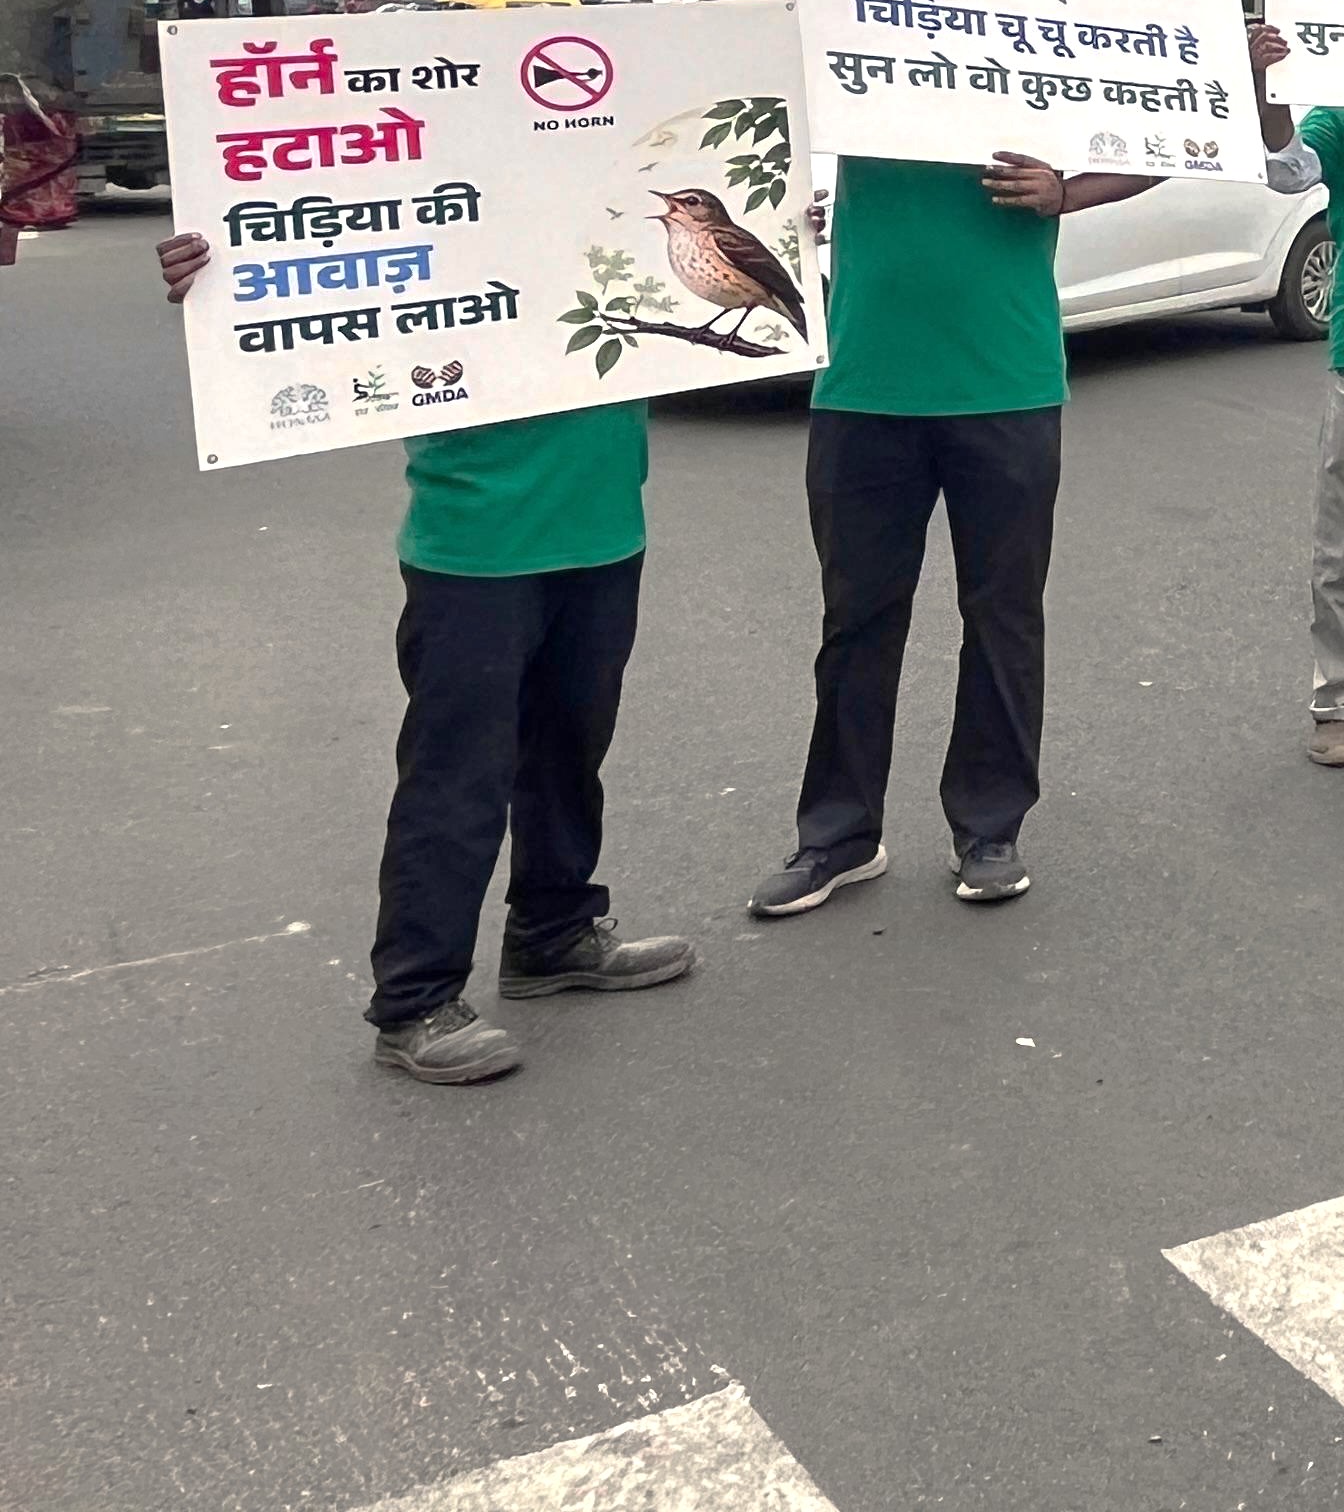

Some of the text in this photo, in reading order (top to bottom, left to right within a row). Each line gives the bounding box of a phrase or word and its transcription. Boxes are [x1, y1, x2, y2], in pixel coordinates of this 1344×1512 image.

[209, 38, 480, 107] हॉर्न का शोर
[996, 13, 1033, 54] चू
[1037, 18, 1076, 58] चू
[1078, 23, 1169, 58] करती
[1173, 27, 1199, 65] है
[827, 50, 1230, 118] सुन लो वो कुछ कहती है
[216, 107, 426, 181] हटाओ
[533, 115, 615, 132] NO HORN
[223, 182, 481, 248] चिड़िया की
[233, 242, 434, 302] आवाज़
[234, 281, 520, 354] वापस लाओ
